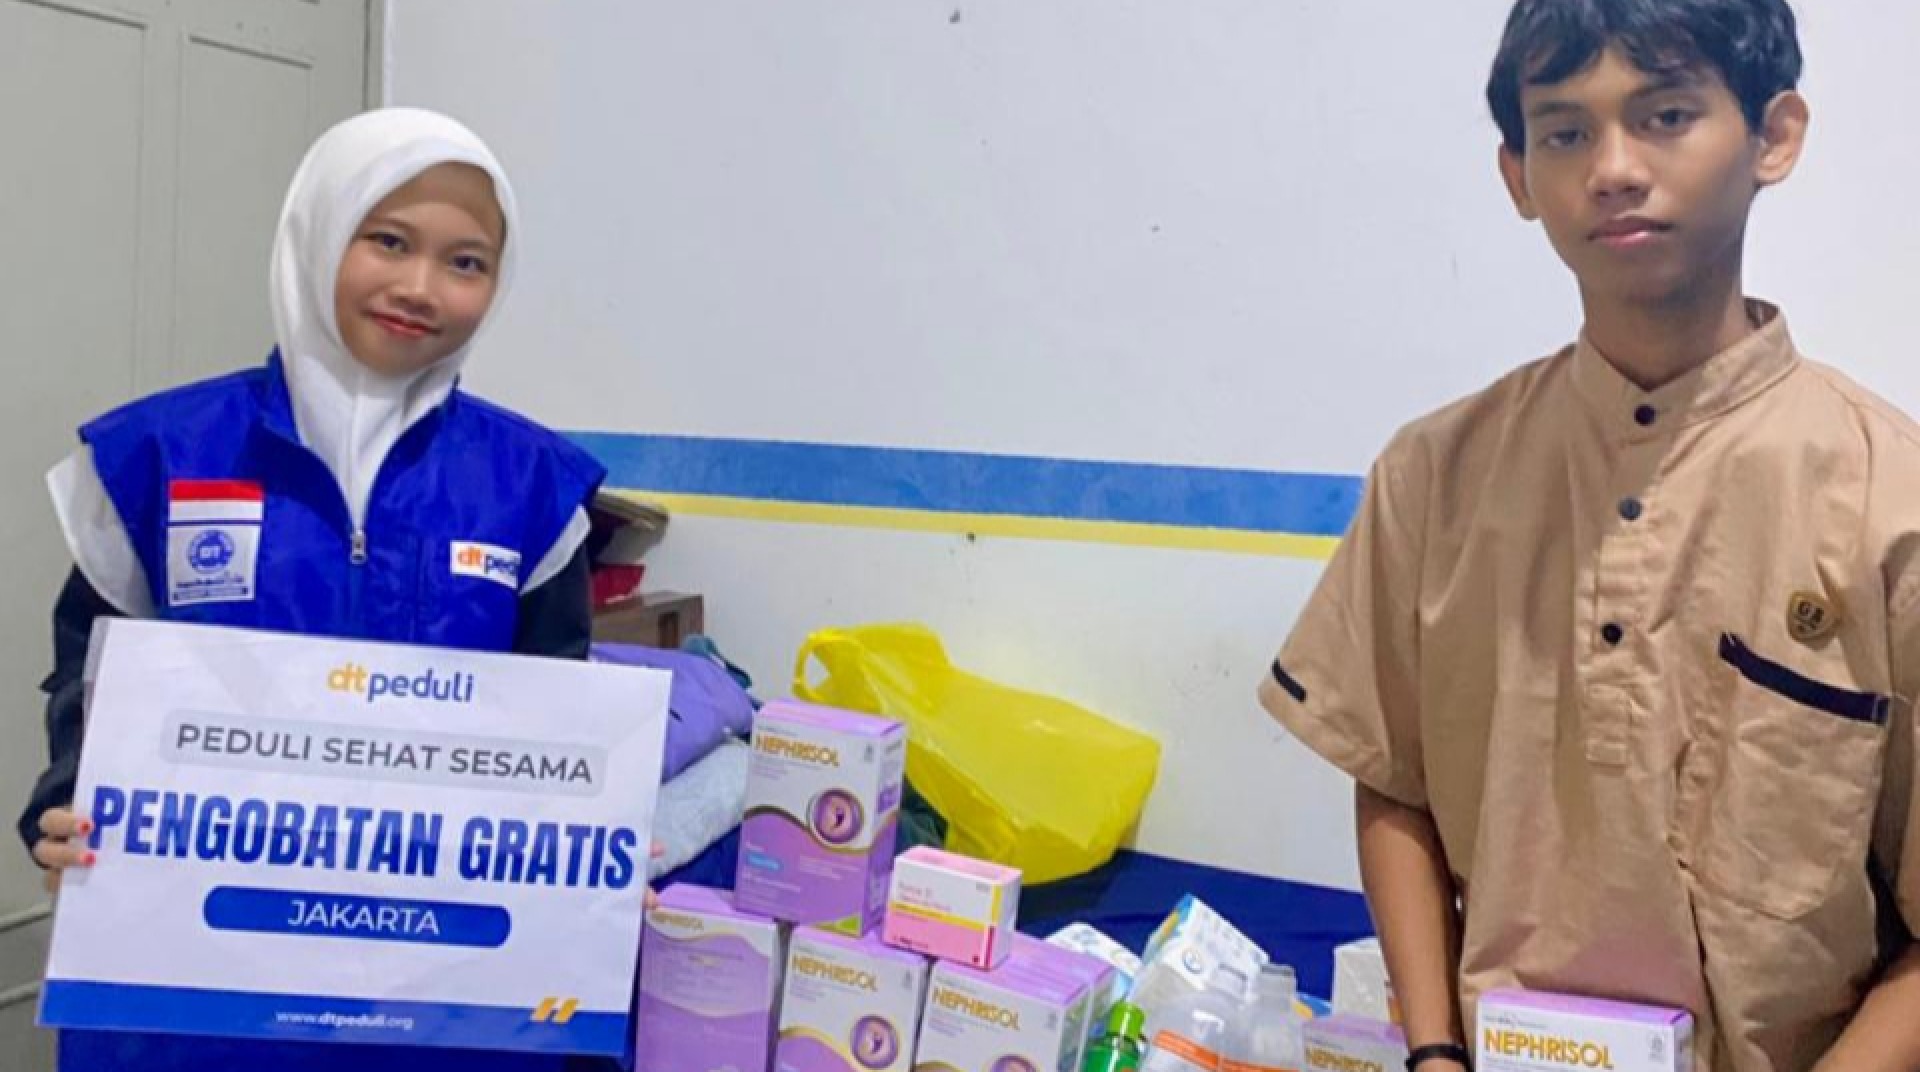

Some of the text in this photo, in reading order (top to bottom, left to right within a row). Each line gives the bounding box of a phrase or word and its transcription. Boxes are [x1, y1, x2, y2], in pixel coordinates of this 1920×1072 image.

[327, 661, 475, 703] dtpeduli
[176, 722, 593, 784] PEDULI SEHAT SESAMA
[755, 732, 840, 768] NEPHRISOL
[88, 784, 637, 890] PENGOBATAN GRATIS
[287, 899, 441, 935] JAKARTA
[791, 952, 878, 993] NEPHRISOL
[275, 1010, 414, 1032] www.dtpeduli.org
[932, 985, 1020, 1033] NEPHRISOL
[1484, 1027, 1615, 1071] NEPHRISOL
